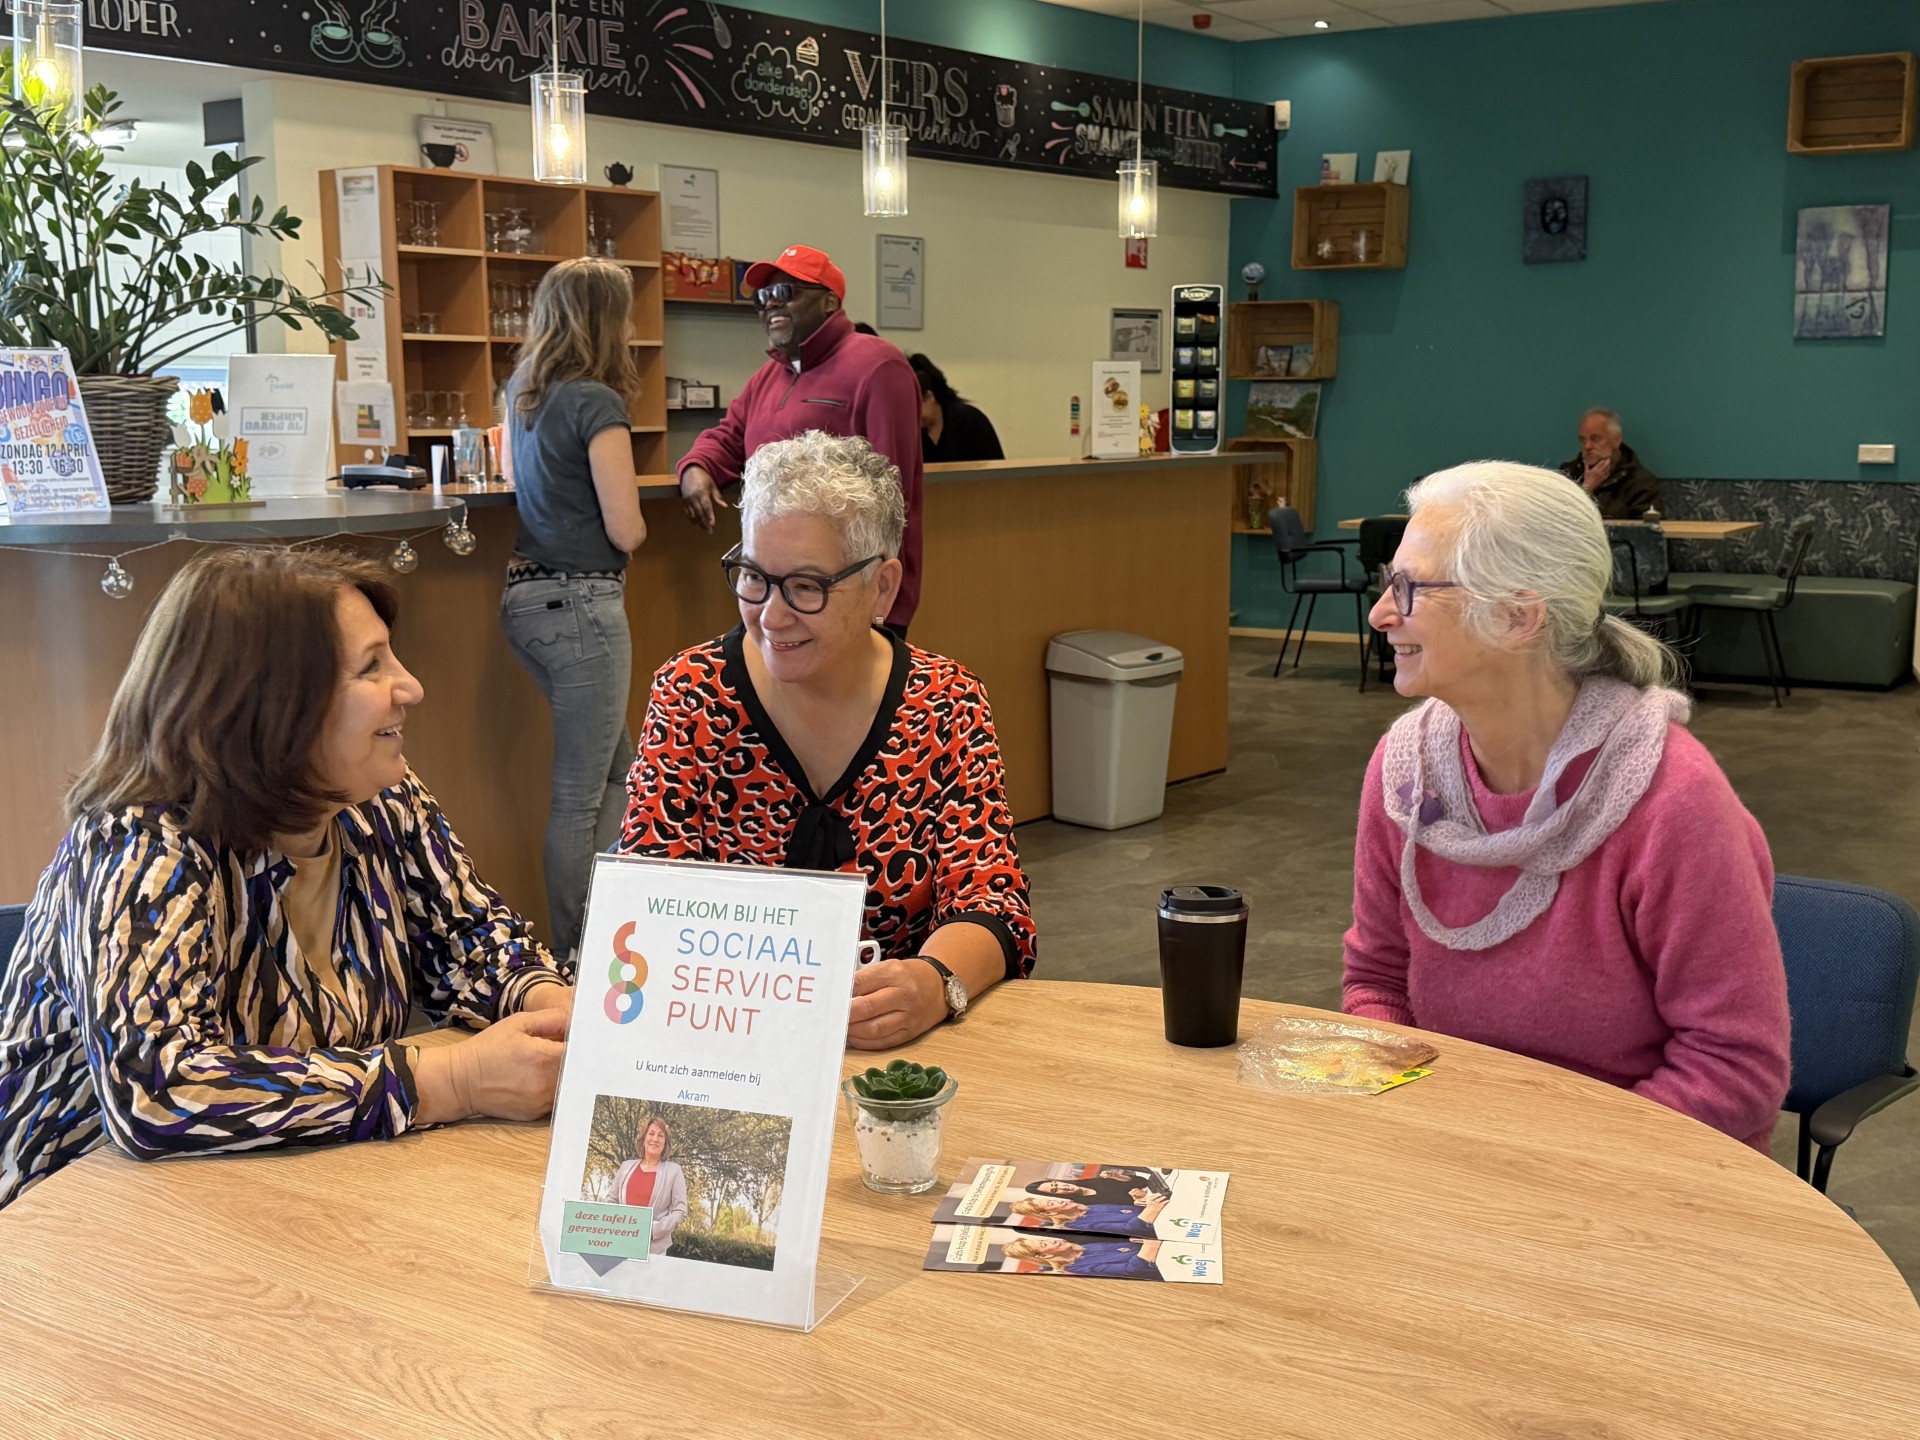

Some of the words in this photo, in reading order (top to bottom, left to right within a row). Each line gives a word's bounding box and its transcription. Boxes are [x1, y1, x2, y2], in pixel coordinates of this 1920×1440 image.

[88, 0, 182, 38] LOPER
[589, 0, 625, 17] EEN
[459, 0, 627, 70] BAKKIE
[441, 35, 520, 82] doen
[541, 53, 650, 98] smen?
[756, 60, 783, 78] elke
[744, 73, 813, 111] donderdag!
[843, 49, 969, 124] VERS
[917, 110, 991, 150] lekkers
[1163, 105, 1211, 139] ETEN
[0, 370, 70, 411] INGO
[14, 415, 69, 441] GEZELLIGHEID
[1, 445, 43, 459] ZONDAG
[46, 444, 57, 458] 12
[60, 443, 90, 457] APRIL
[12, 460, 43, 475] 13:30
[54, 459, 84, 474] 16:30
[647, 896, 729, 921] WELKOM
[733, 902, 758, 924] BIJ
[763, 906, 799, 927] HET
[676, 928, 822, 967] SOCIAAL
[671, 964, 816, 1004] SERVICE
[666, 1001, 761, 1036] PUNT
[635, 1060, 644, 1072] U
[646, 1061, 668, 1075] kunt
[669, 1063, 690, 1077] zich
[691, 1065, 746, 1083] aanmelden
[749, 1070, 762, 1086] bij
[677, 1089, 710, 1103] Akram
[574, 1209, 600, 1222] deze
[601, 1211, 627, 1224] tafel
[629, 1214, 638, 1225] is
[1185, 1222, 1212, 1238] Woej
[567, 1223, 640, 1240] gereserveerd
[587, 1237, 613, 1248] voor
[1191, 1259, 1217, 1277] Woej
